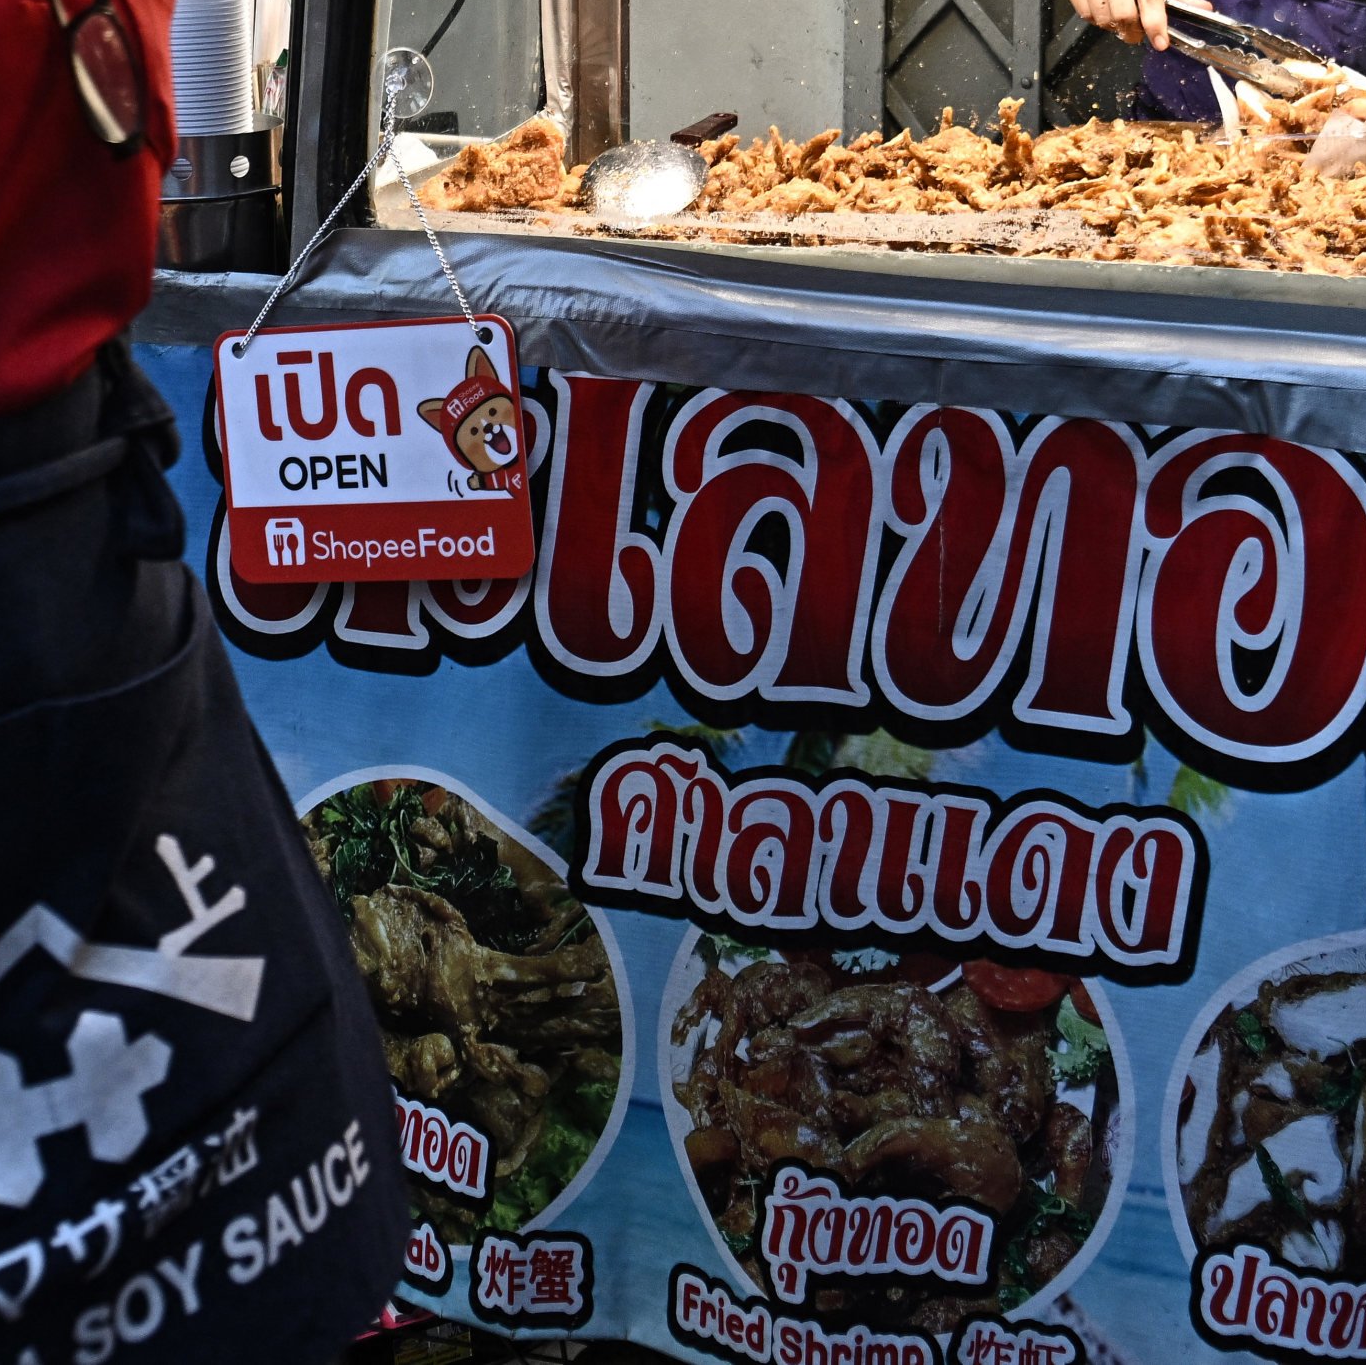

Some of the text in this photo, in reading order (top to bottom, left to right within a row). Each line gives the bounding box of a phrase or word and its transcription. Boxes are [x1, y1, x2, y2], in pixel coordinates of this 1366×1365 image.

[254, 350, 402, 442] เปิด
[461, 387, 486, 409] Food
[279, 453, 388, 491] OPEN
[313, 527, 495, 568] ShopeeFood
[590, 742, 1190, 966] ศาลาแดง
[73, 1118, 372, 1365] SOY SAUCE
[767, 1175, 985, 1295] กุ้งทอด
[485, 1246, 575, 1306] 炸蟹
[682, 1282, 765, 1354] Fried
